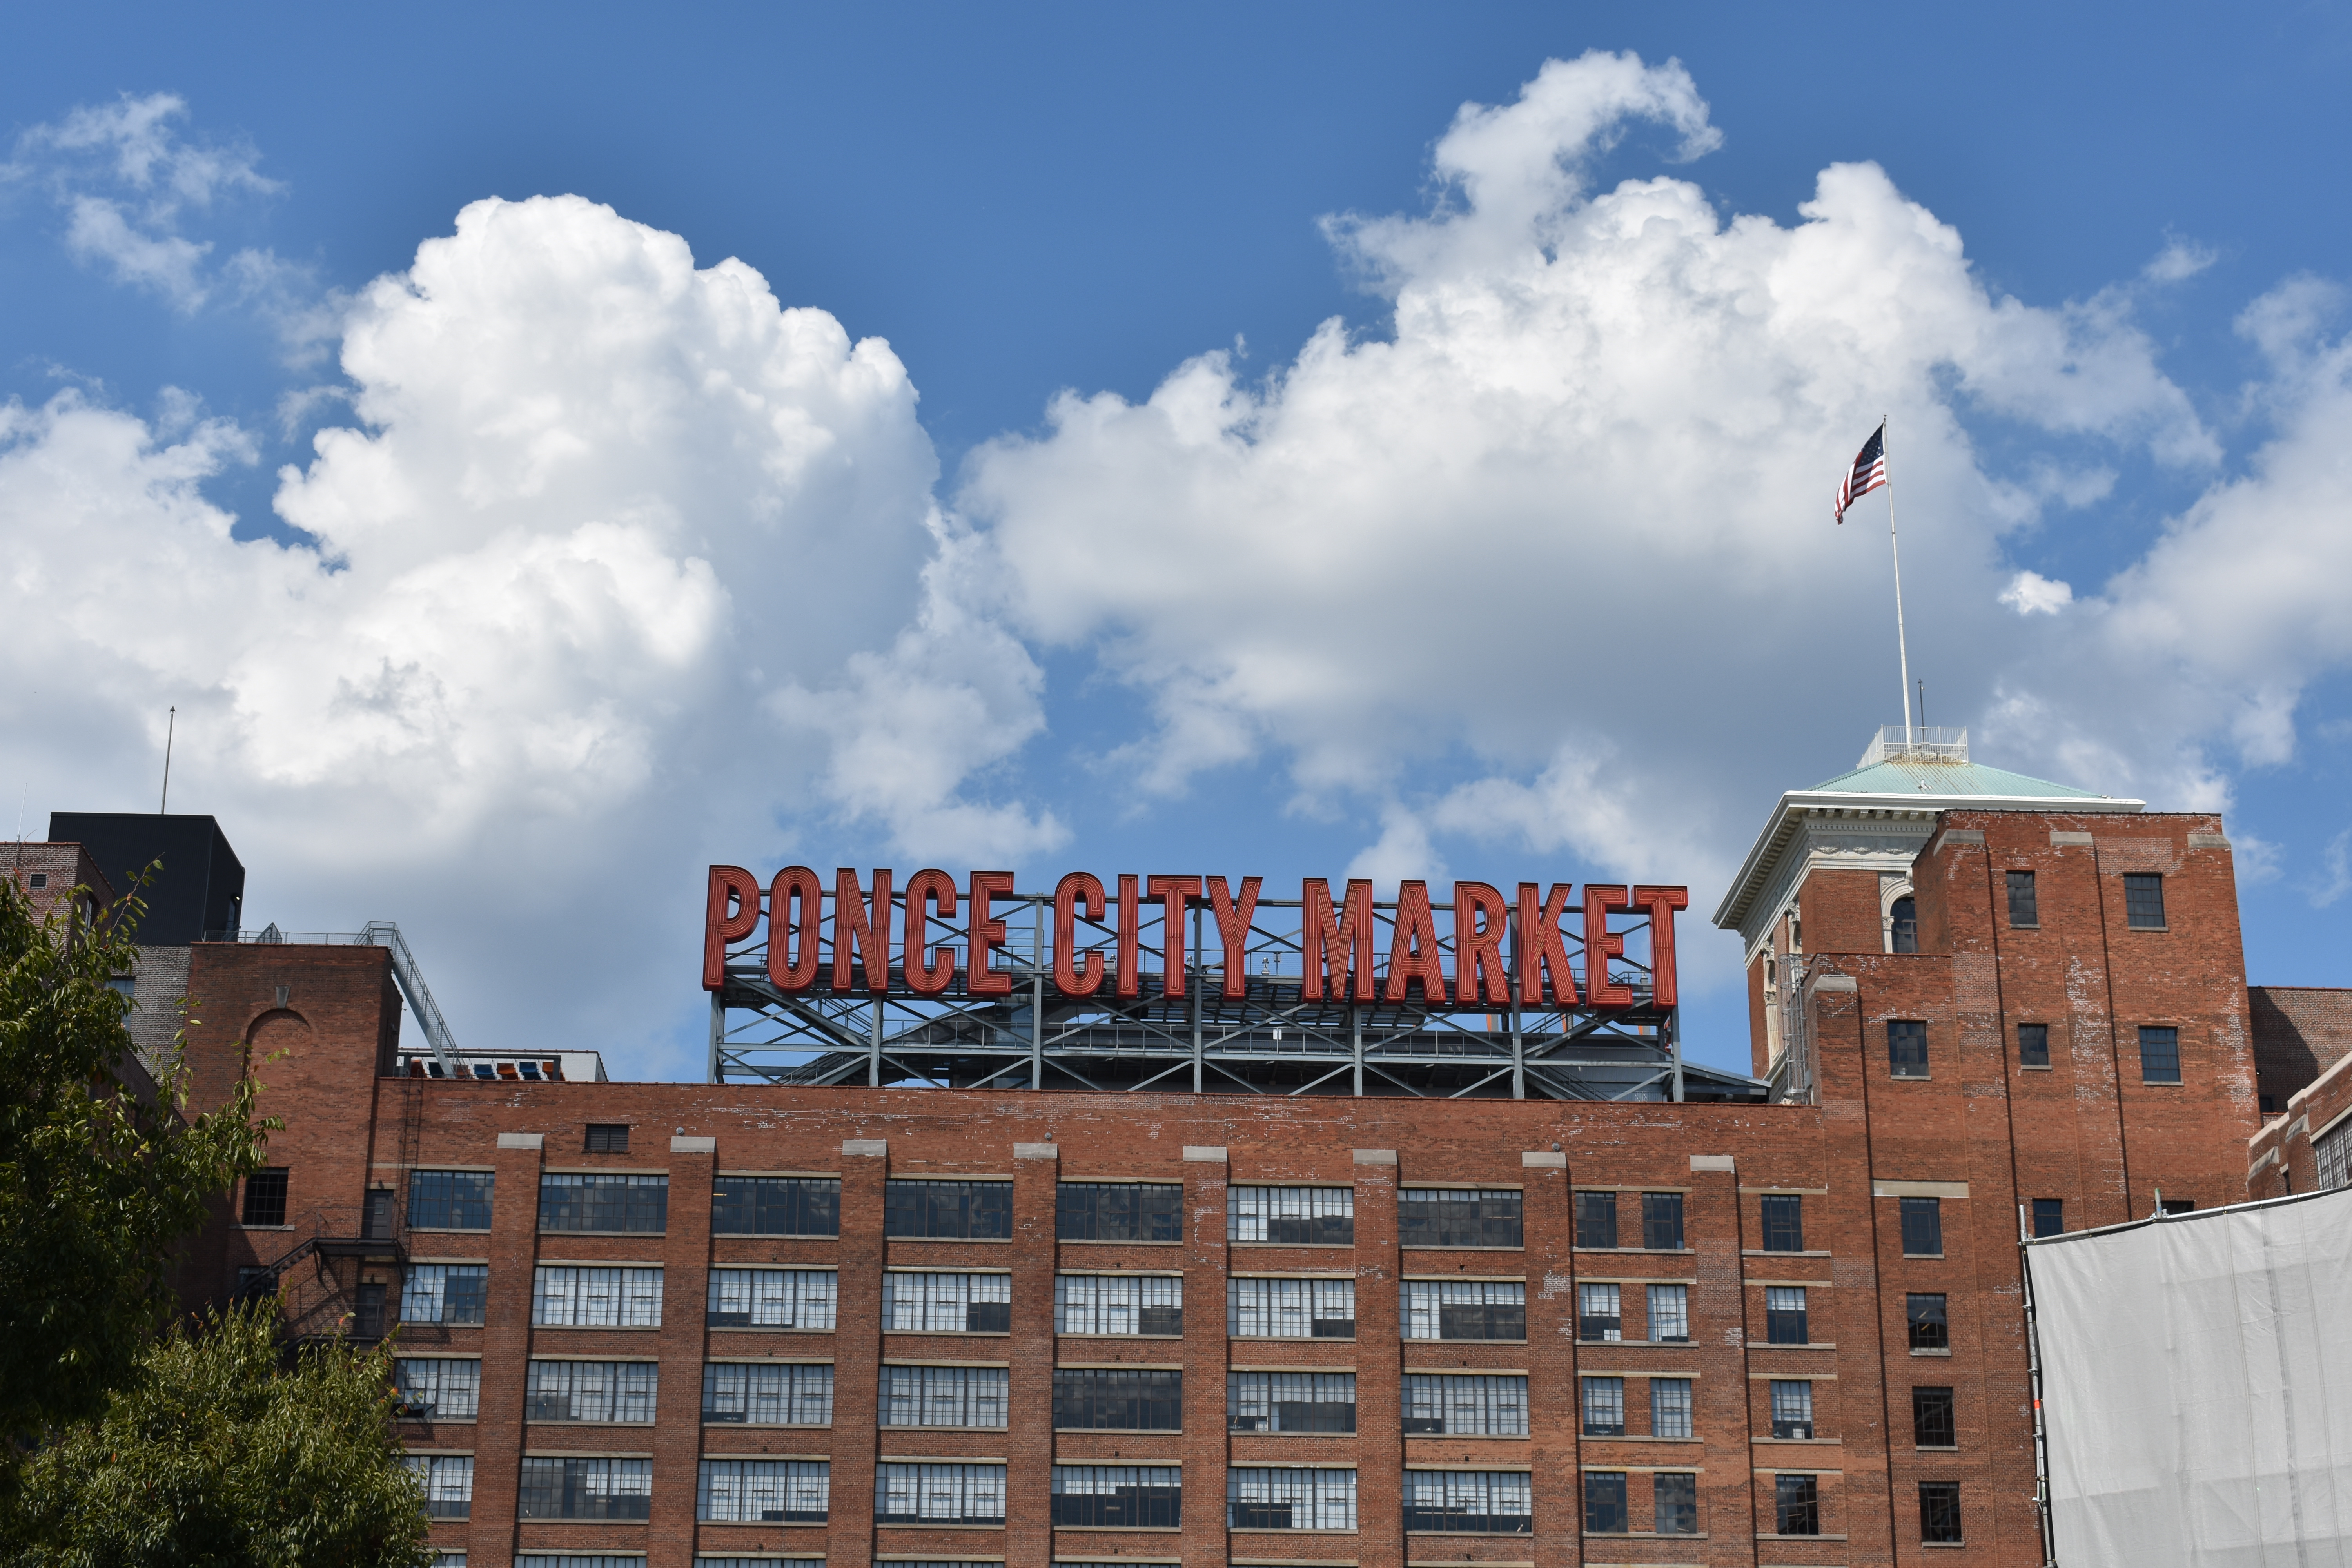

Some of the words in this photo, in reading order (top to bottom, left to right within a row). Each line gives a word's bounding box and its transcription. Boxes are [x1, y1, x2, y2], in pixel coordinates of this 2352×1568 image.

[704, 866, 1014, 995] PONCE
[1053, 872, 1263, 1000] CITY
[1301, 878, 1688, 1009] MARKET
